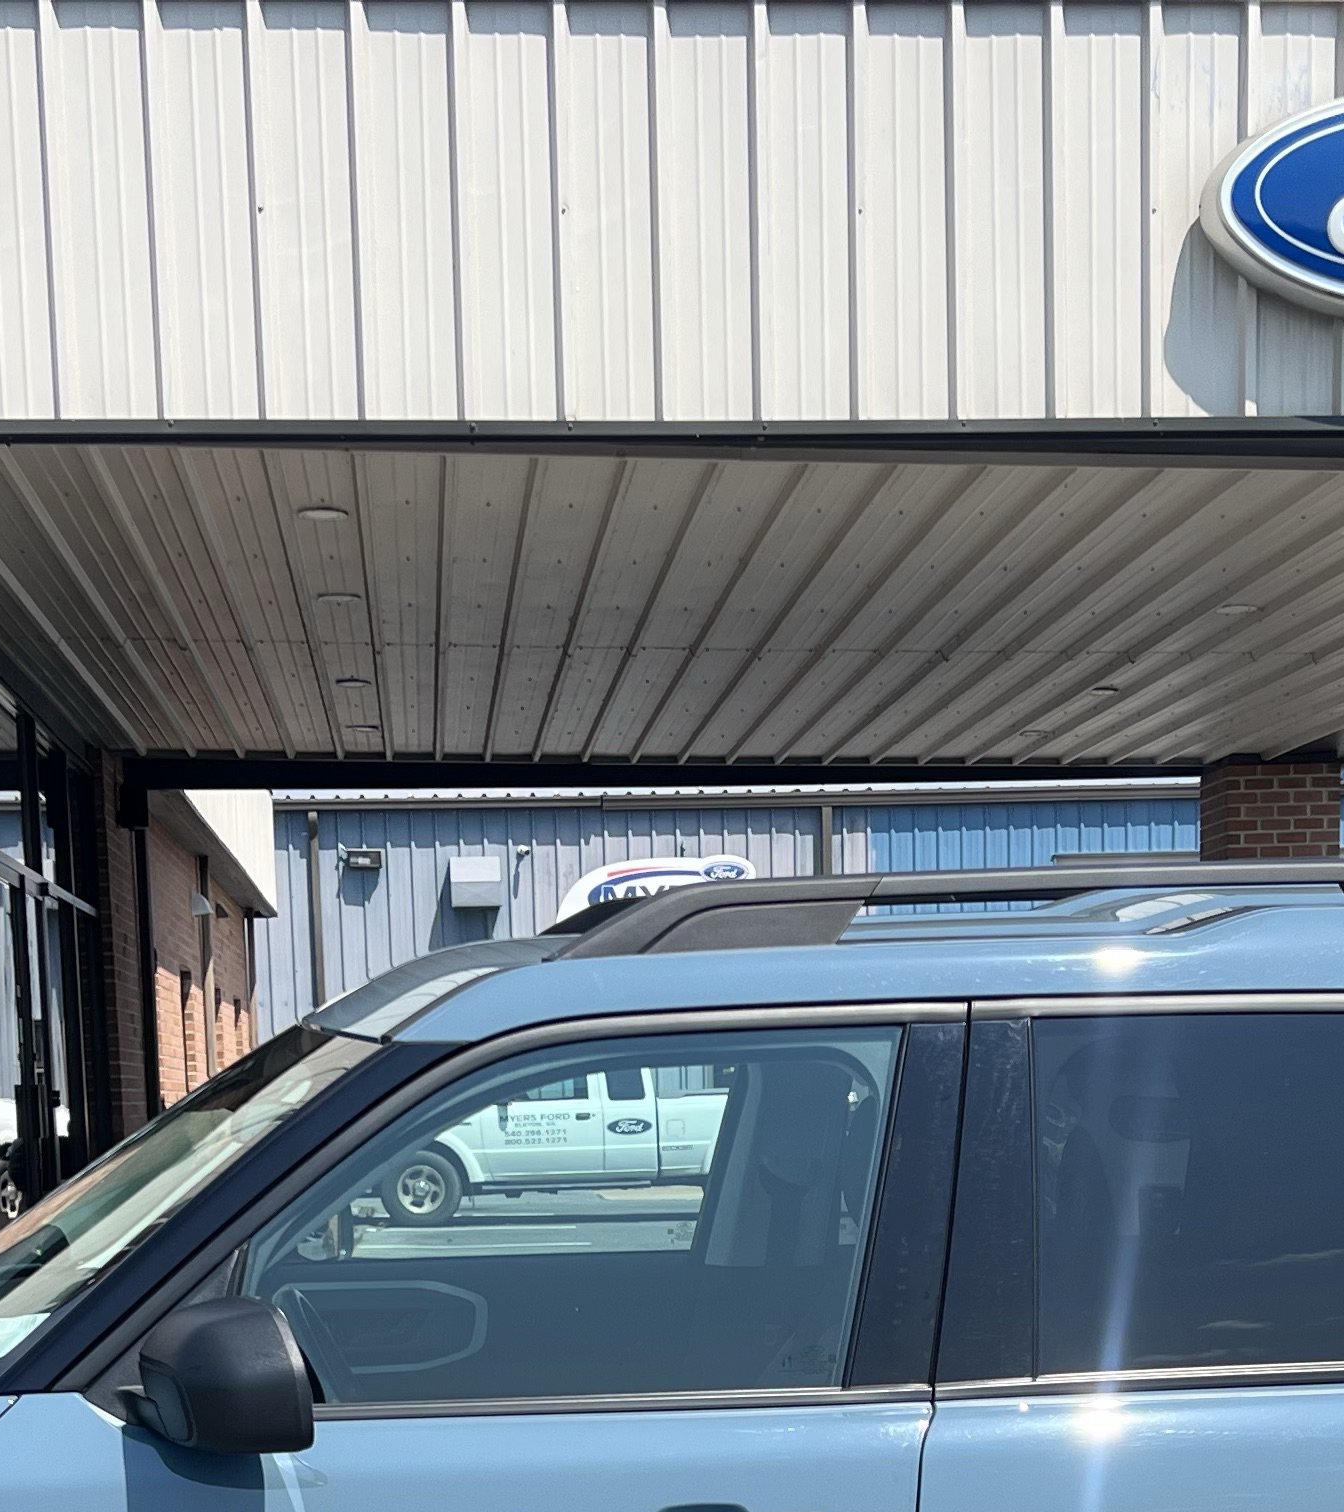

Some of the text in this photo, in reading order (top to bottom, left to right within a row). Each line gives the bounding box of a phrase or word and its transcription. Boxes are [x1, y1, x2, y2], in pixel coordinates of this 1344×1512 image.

[710, 864, 738, 879] Ford
[540, 1113, 570, 1121] FORD
[615, 1120, 645, 1133] Ford
